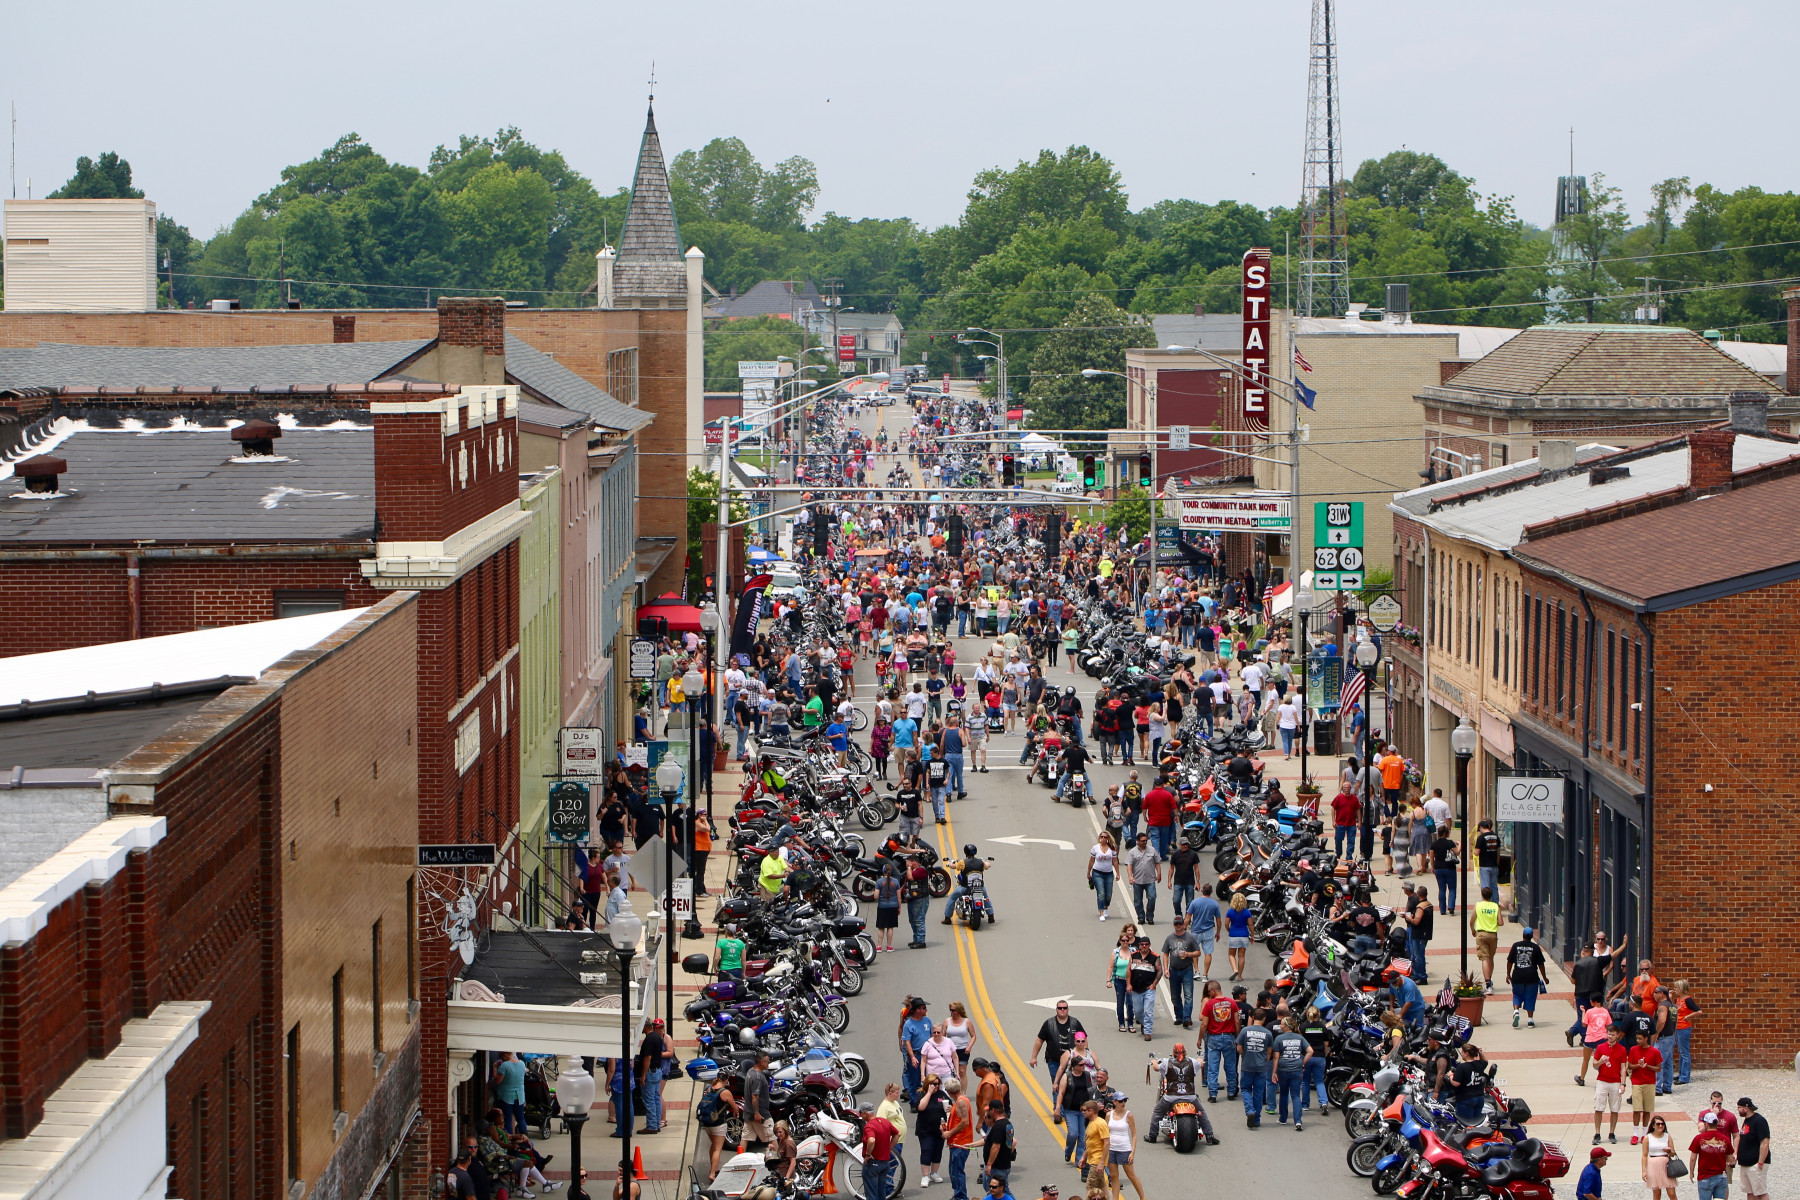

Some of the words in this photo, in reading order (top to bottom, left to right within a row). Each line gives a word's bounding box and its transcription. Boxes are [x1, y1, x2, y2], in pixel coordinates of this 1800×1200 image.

[1245, 265, 1266, 412] STATE
[1182, 500, 1199, 509] YOUR
[1201, 501, 1238, 510] COMMUNITY
[1239, 502, 1257, 511] BANK
[1259, 503, 1278, 512] MOVIE
[1182, 515, 1205, 524] CLOUDY
[1206, 516, 1223, 525] WITH
[1330, 508, 1348, 521] 31W
[1260, 518, 1283, 526] Mulberry
[1318, 552, 1335, 566] 62
[1344, 552, 1356, 566] 61
[746, 591, 763, 636] BURNOUT
[1331, 662, 1340, 704] HISTORIC
[557, 799, 583, 811] 120
[1501, 803, 1558, 811] CLAGETT
[552, 811, 587, 825] West
[663, 898, 690, 912] OPEN
